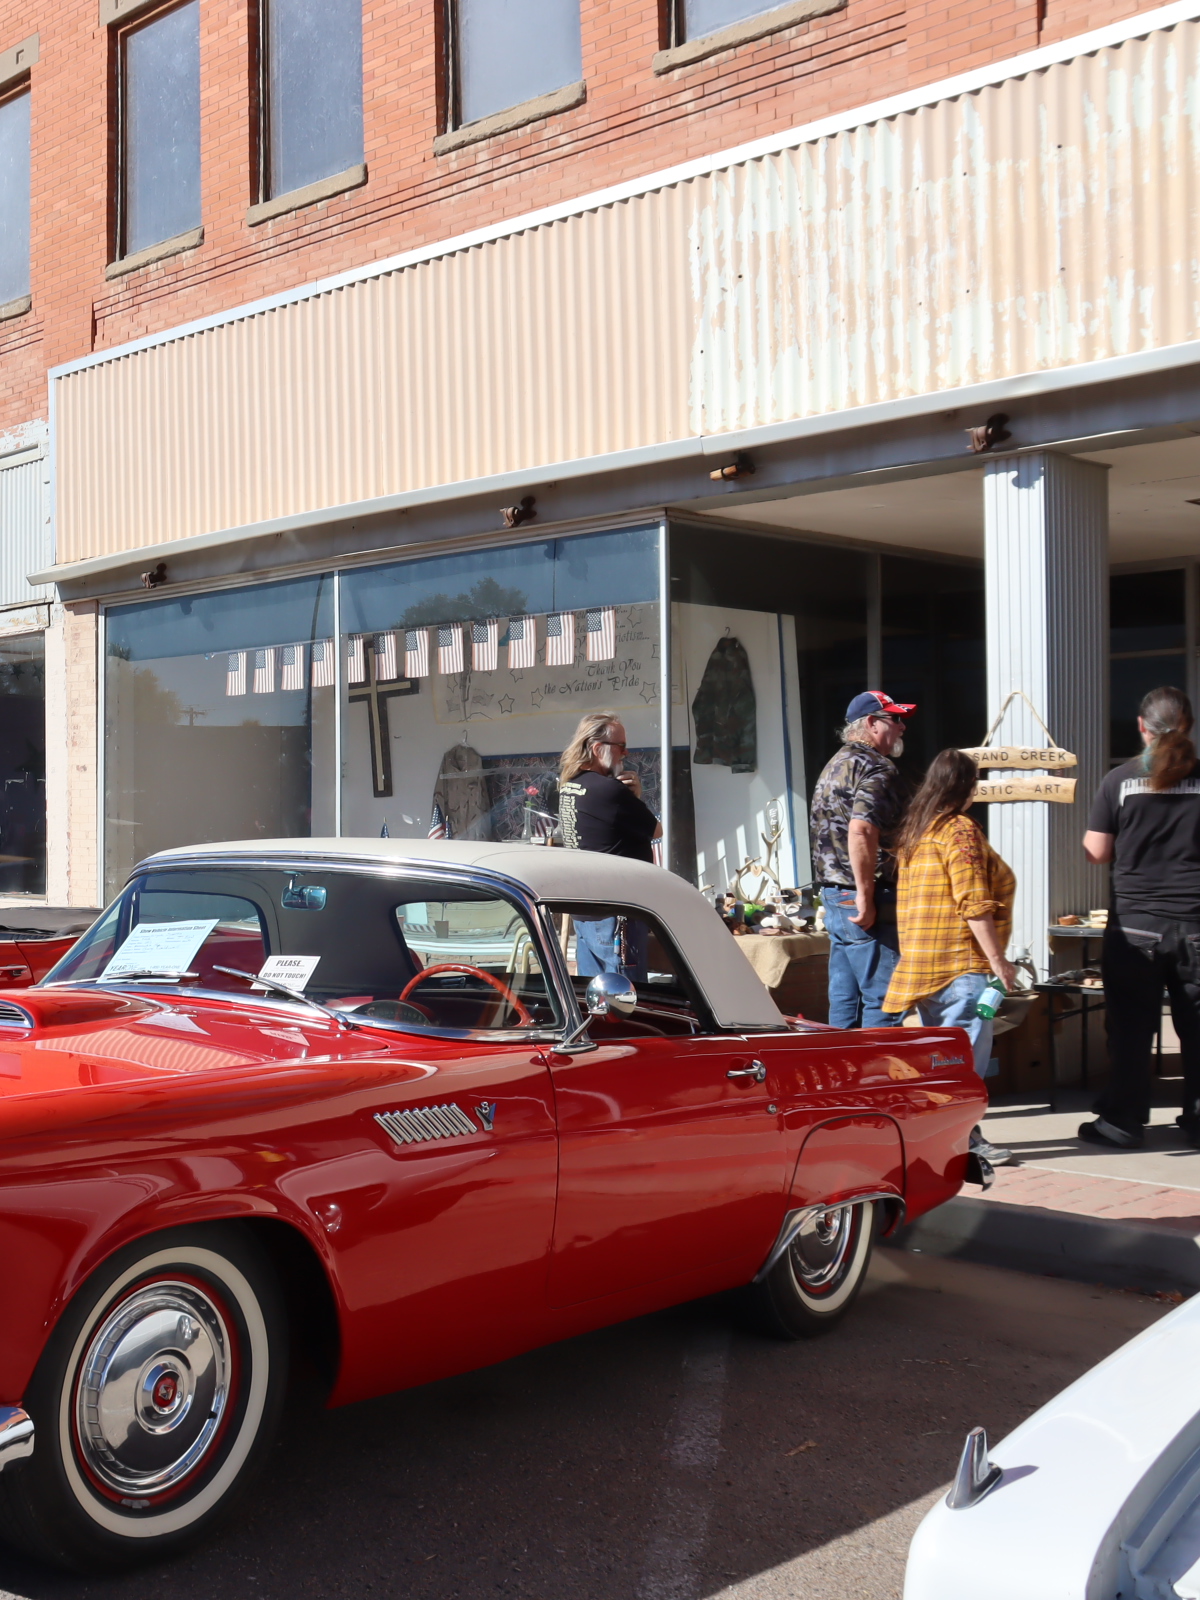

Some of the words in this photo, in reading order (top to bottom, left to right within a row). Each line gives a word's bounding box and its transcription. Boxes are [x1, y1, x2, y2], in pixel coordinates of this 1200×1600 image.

[585, 661, 615, 677] Thank
[619, 658, 642, 678] You
[544, 683, 557, 695] the
[560, 679, 603, 695] Nation's
[608, 675, 640, 691] Pride
[973, 751, 1009, 762] SAND
[1020, 751, 1067, 762] CREEK
[973, 785, 1013, 797] USTIC
[1034, 784, 1061, 794] ART
